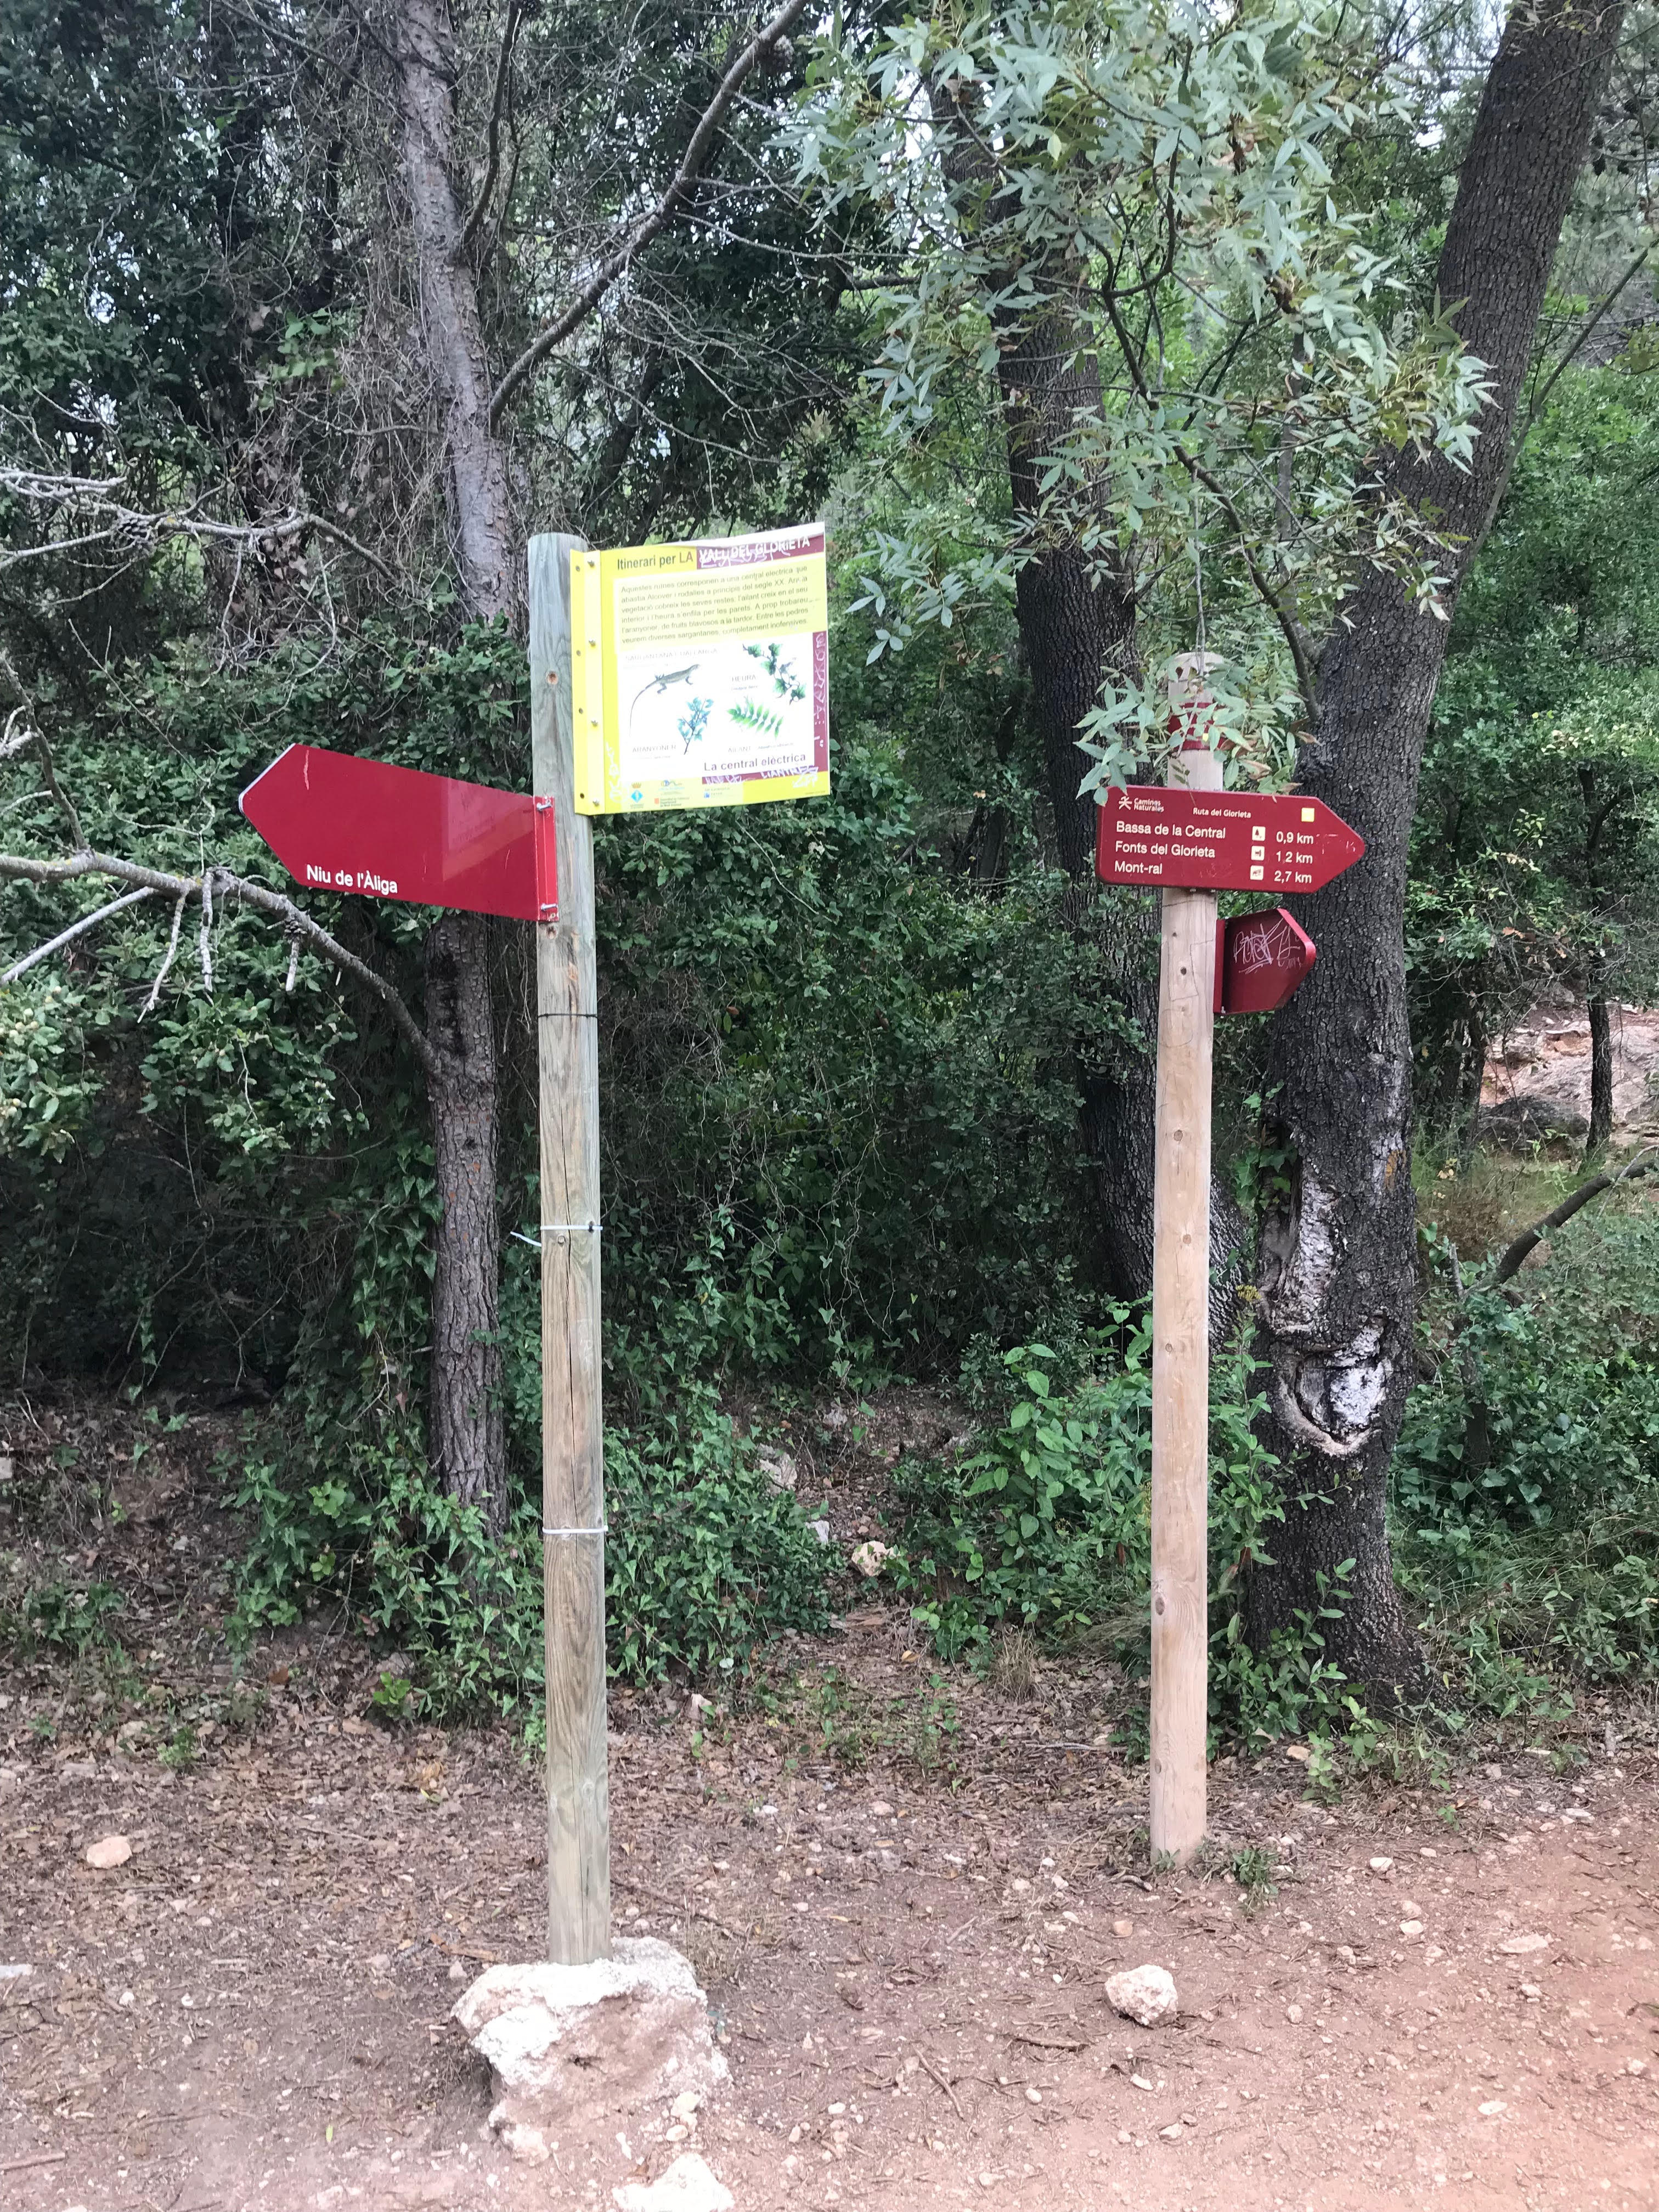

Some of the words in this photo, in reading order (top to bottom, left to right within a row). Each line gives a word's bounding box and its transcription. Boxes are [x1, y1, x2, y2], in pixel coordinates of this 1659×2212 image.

[617, 555, 656, 571] Itinerari
[659, 555, 676, 568] per
[679, 551, 693, 563] LA
[704, 762, 717, 771] La
[721, 758, 758, 770] central
[761, 753, 806, 766] elèctrica
[1134, 798, 1161, 806] Caminos
[1134, 803, 1164, 812] Naturales
[1193, 807, 1209, 816] Ruta
[1210, 808, 1222, 816] del
[1223, 809, 1251, 819] Glorieta
[1116, 821, 1151, 834] Bassa
[1154, 823, 1169, 836] de
[1172, 824, 1182, 836] la
[1186, 825, 1226, 839] Central
[1276, 831, 1294, 845] 0,9
[1297, 832, 1314, 845] km
[1115, 840, 1147, 854] Fonts
[1150, 843, 1167, 855] del
[1171, 844, 1216, 859] Glorieta
[1296, 851, 1313, 864] km
[306, 864, 331, 884] Niu
[335, 870, 353, 887] de
[357, 870, 398, 895] l'Àliga
[1114, 860, 1163, 875] Mont-ral
[1274, 870, 1292, 884] 2,7
[1295, 871, 1312, 884] km
